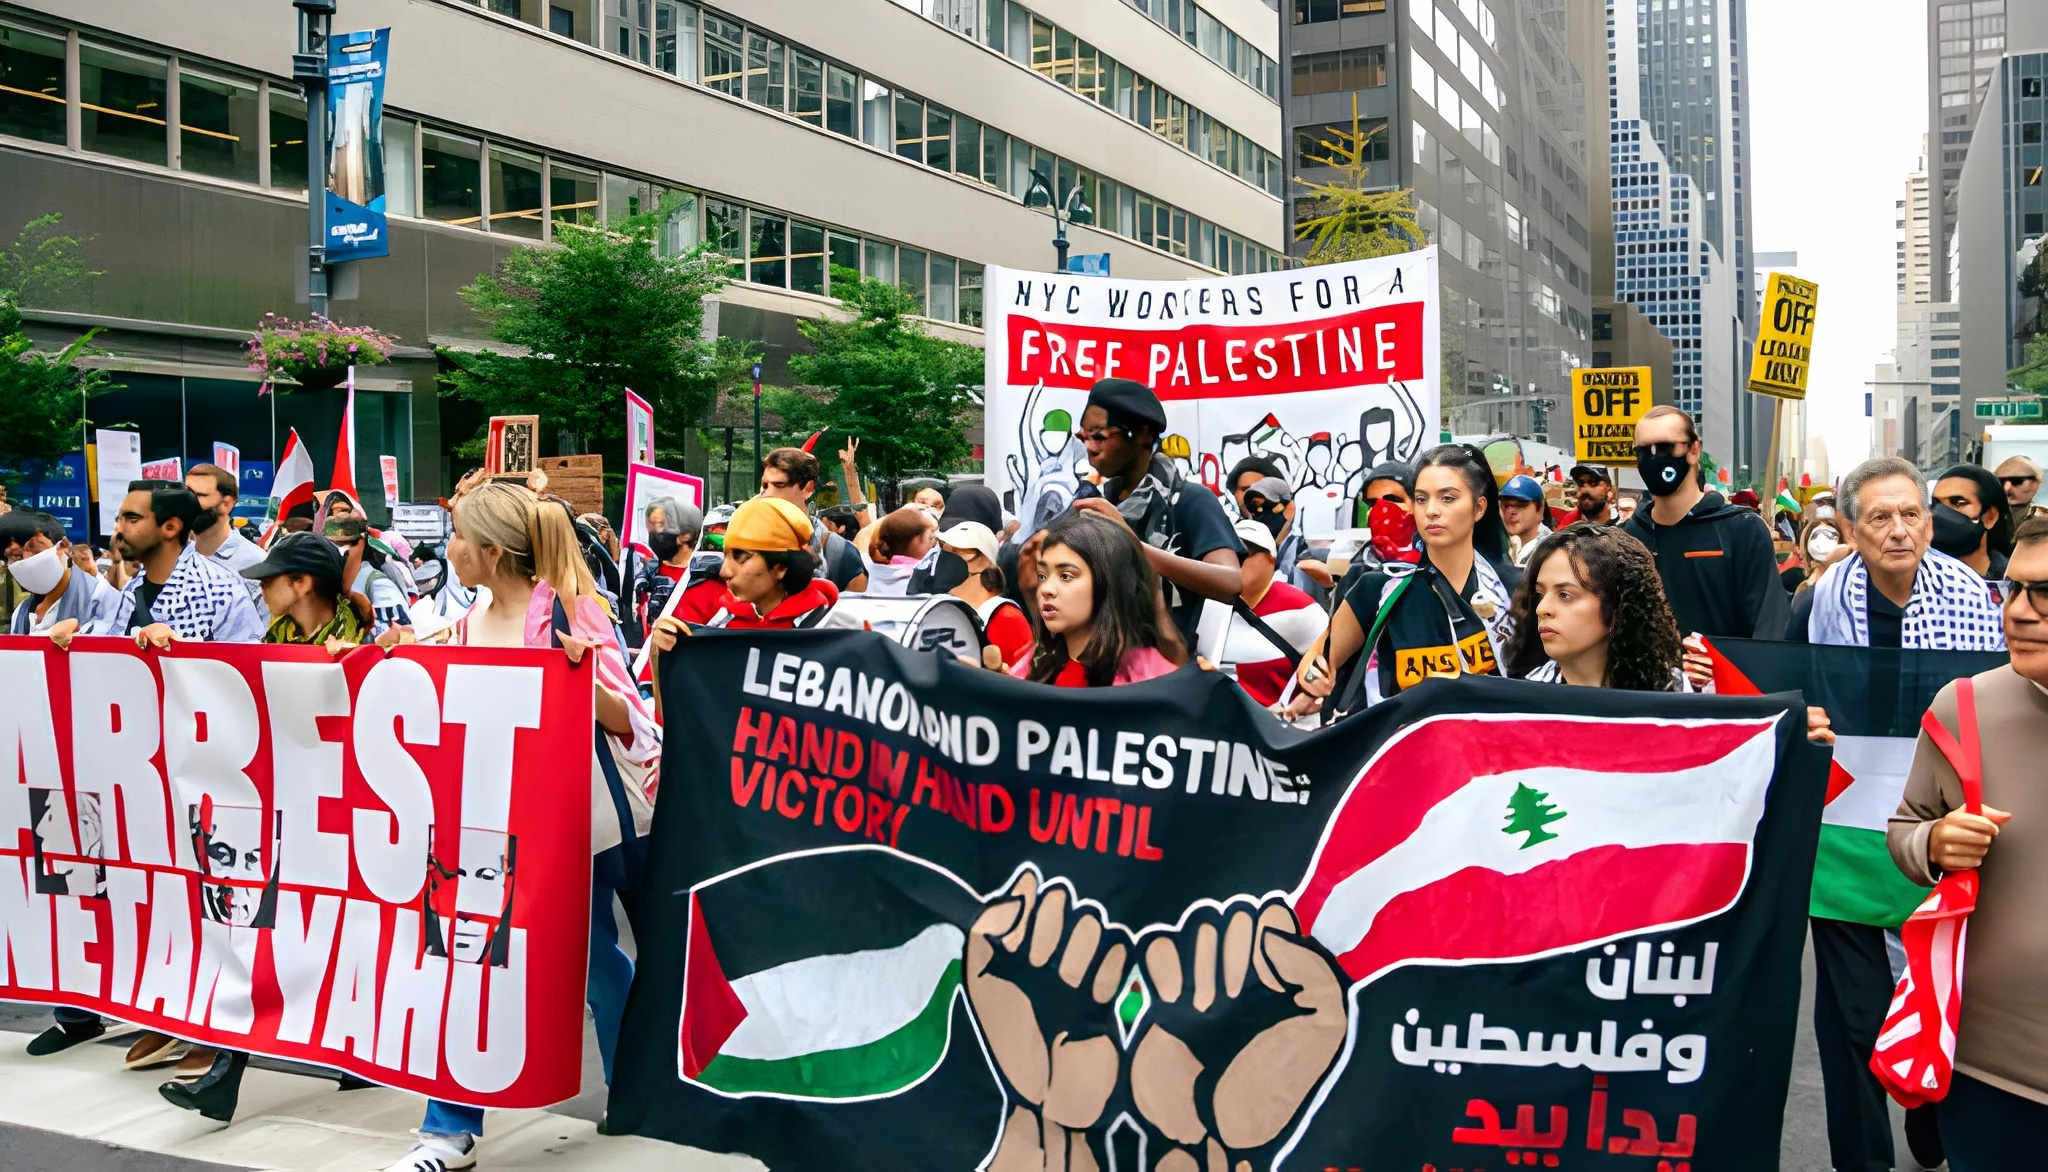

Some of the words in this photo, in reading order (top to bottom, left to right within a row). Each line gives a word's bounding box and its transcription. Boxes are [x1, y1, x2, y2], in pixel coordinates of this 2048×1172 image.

[1015, 280, 1081, 314] NYC
[1289, 275, 1361, 312] FOR
[1388, 267, 1404, 295] A
[1020, 329, 1123, 378] FREE
[1148, 322, 1397, 389] PALESTINE
[1583, 387, 1640, 417] OFF
[0, 649, 543, 904] ARREST
[732, 706, 865, 780] HAND
[867, 738, 911, 789] IN
[1027, 787, 1165, 862] UNTIL
[0, 855, 527, 1093] NETANYAHU
[1585, 940, 1720, 1008] لبنان
[1390, 1007, 1708, 1085] وفلسطين
